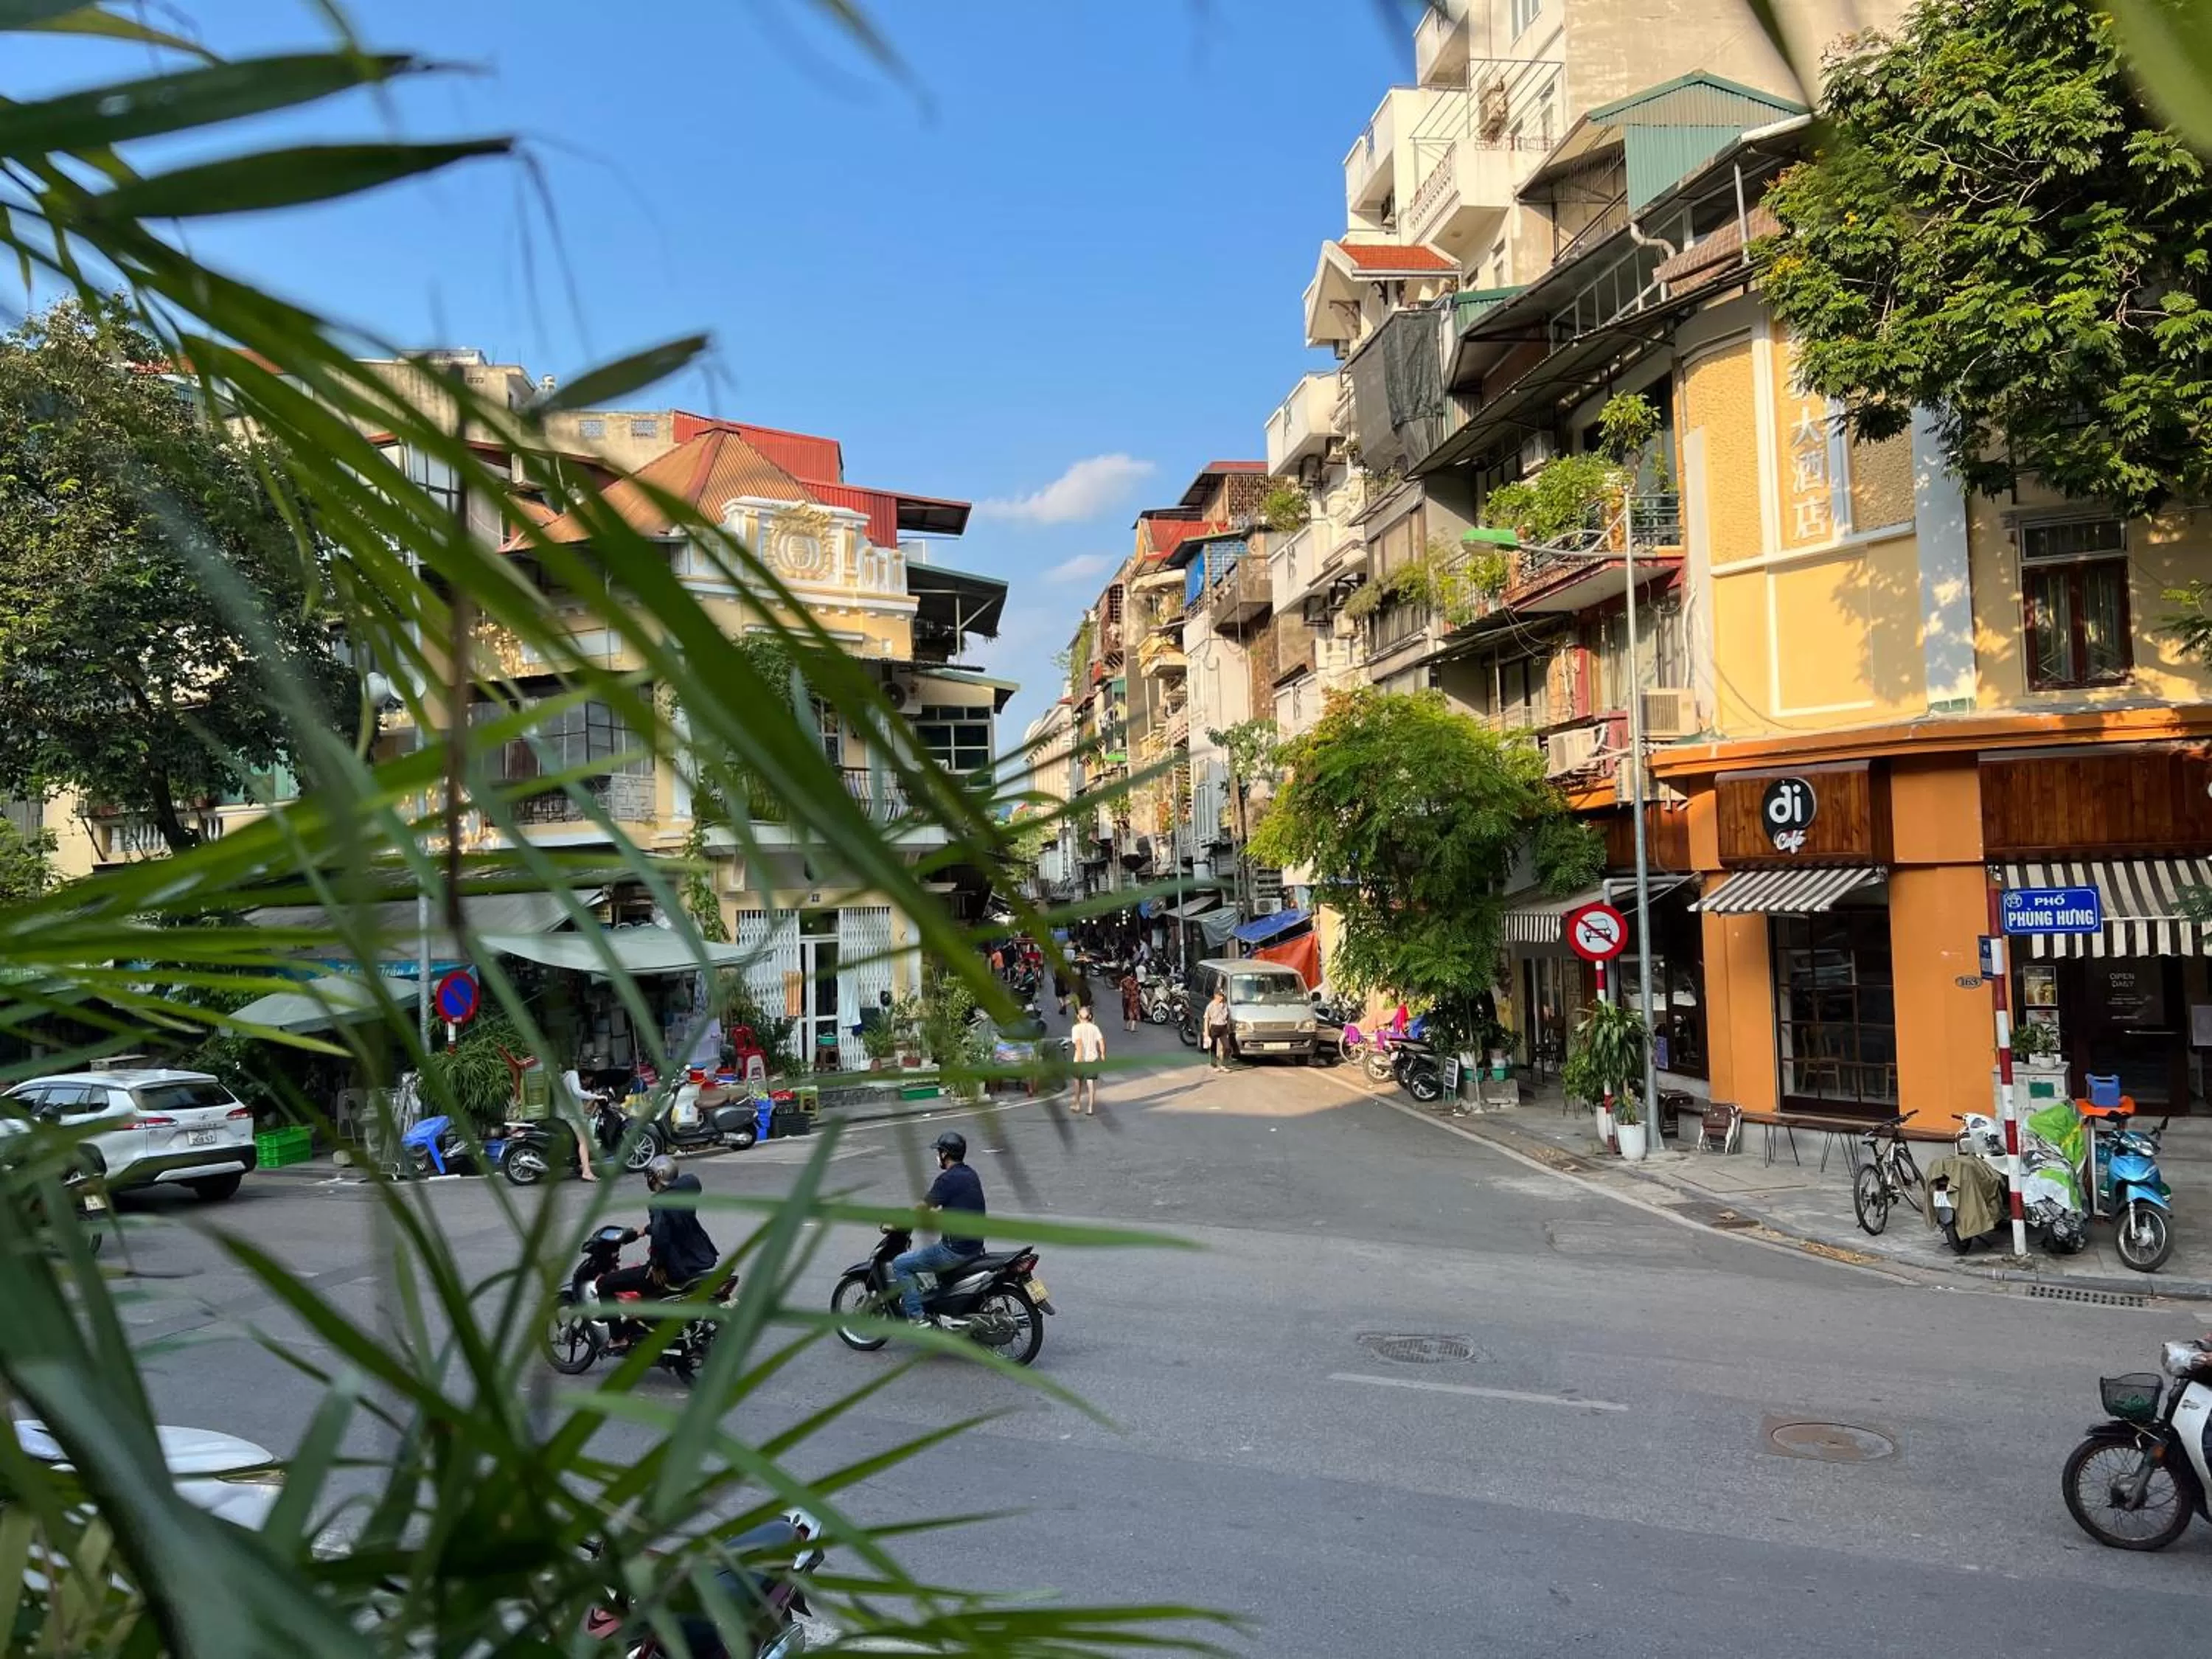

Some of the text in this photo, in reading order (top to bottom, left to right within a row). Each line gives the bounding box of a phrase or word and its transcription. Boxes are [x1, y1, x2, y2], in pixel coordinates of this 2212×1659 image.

[2034, 893, 2065, 906] PHỐ
[2008, 908, 2095, 927] PHÙNG HƯNG
